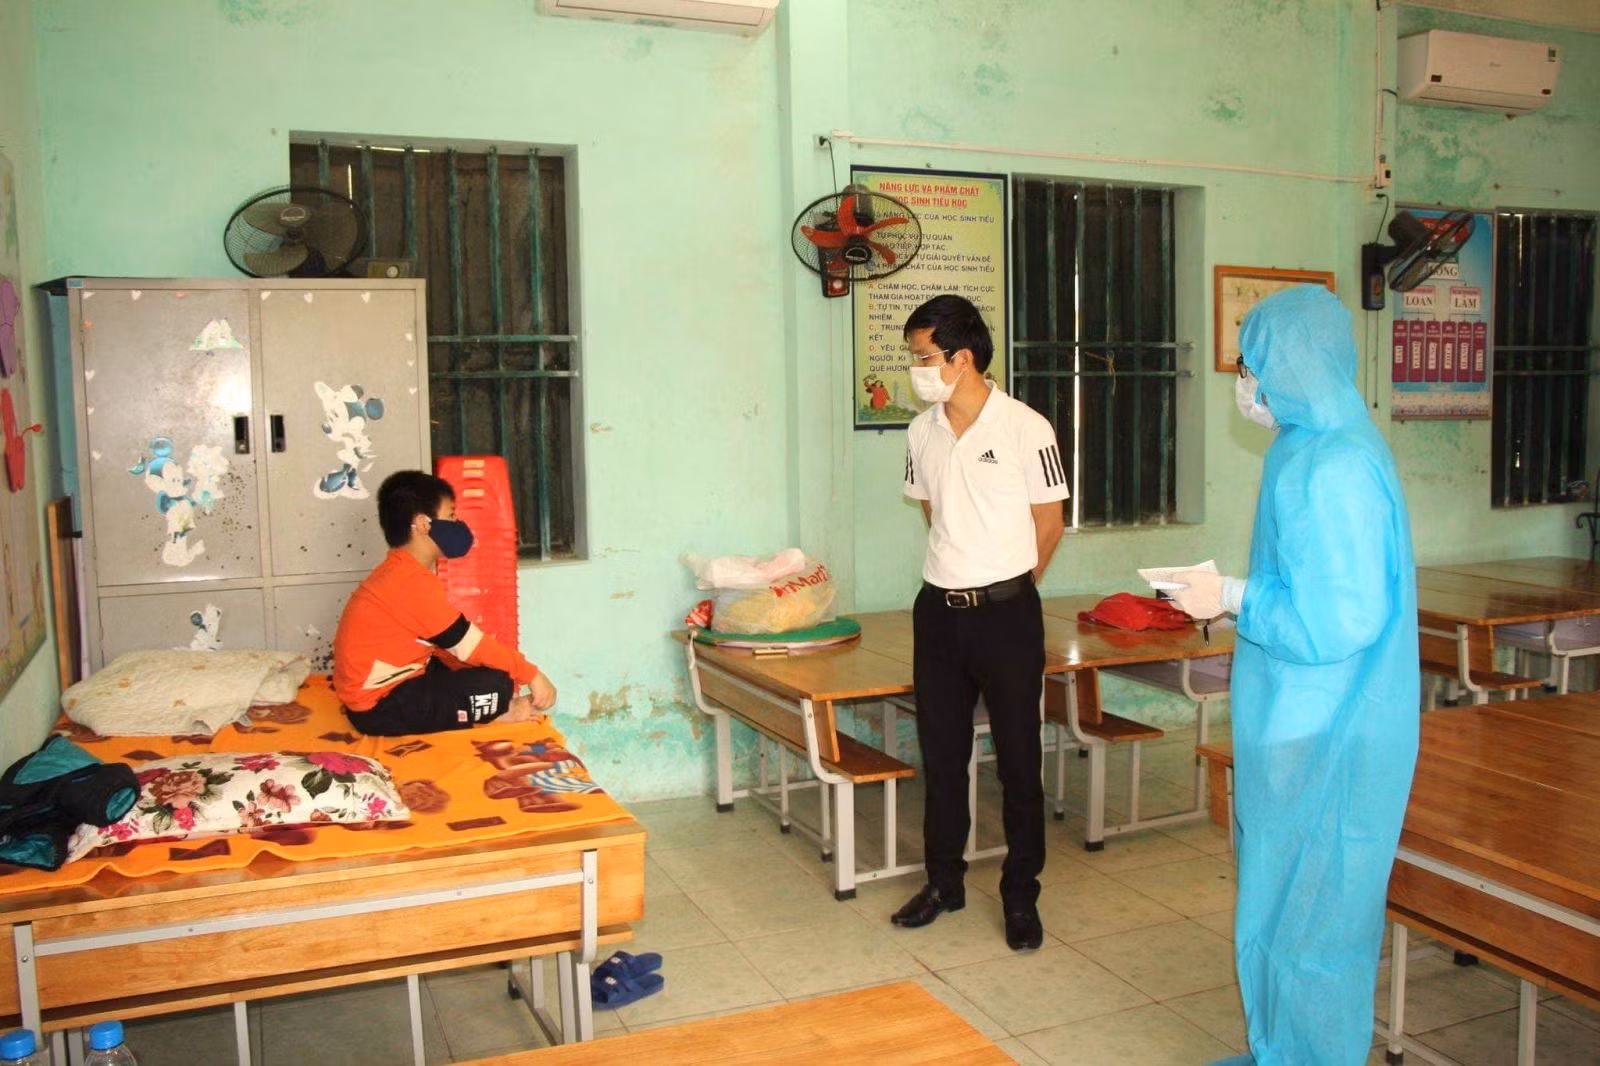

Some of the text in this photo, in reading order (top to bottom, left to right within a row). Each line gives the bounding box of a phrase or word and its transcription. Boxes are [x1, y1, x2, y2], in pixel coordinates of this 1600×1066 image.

[911, 197, 931, 206] SINH
[961, 265, 978, 273] SINH
[891, 293, 903, 301] GIA
[1405, 295, 1433, 306] LOAN
